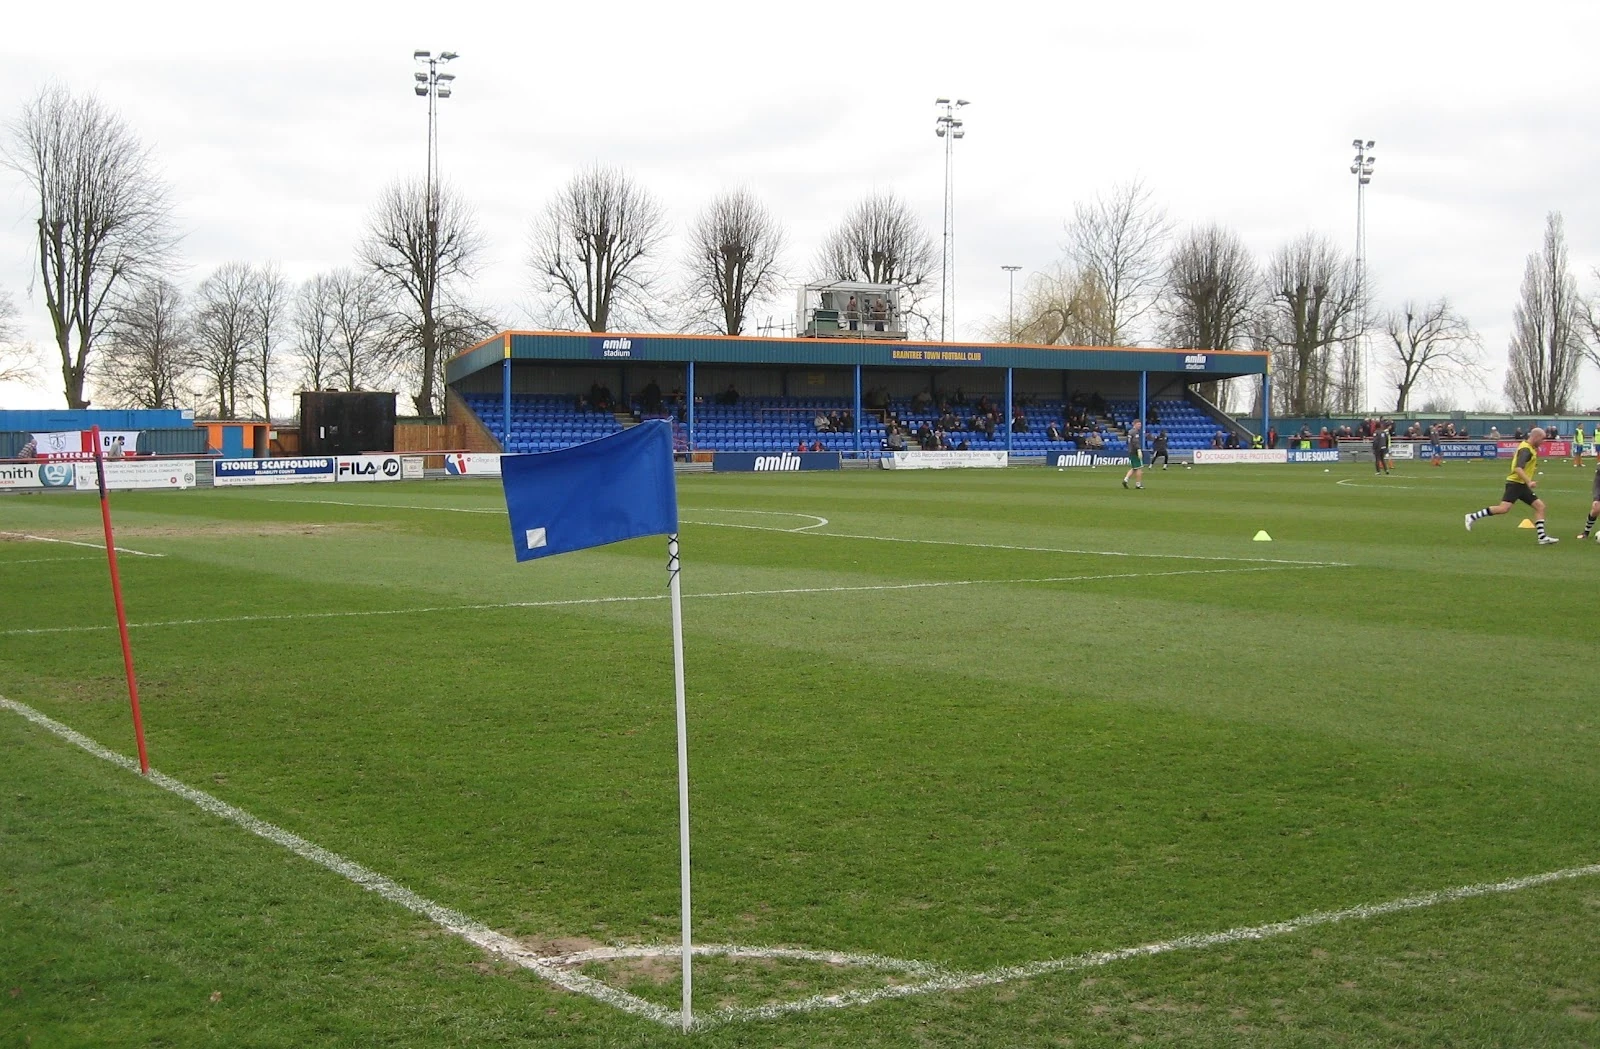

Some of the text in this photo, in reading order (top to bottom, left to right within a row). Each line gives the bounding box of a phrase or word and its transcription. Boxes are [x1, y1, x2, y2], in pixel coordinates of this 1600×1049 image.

[892, 350, 922, 359] BRAINTREE
[924, 352, 940, 360] TOWN
[942, 352, 966, 360] FOOTBALL
[221, 460, 328, 470] STONES SCAFFOLDING
[1093, 454, 1131, 466] Insuran
[340, 462, 377, 475] FILA
[385, 462, 398, 472] JD
